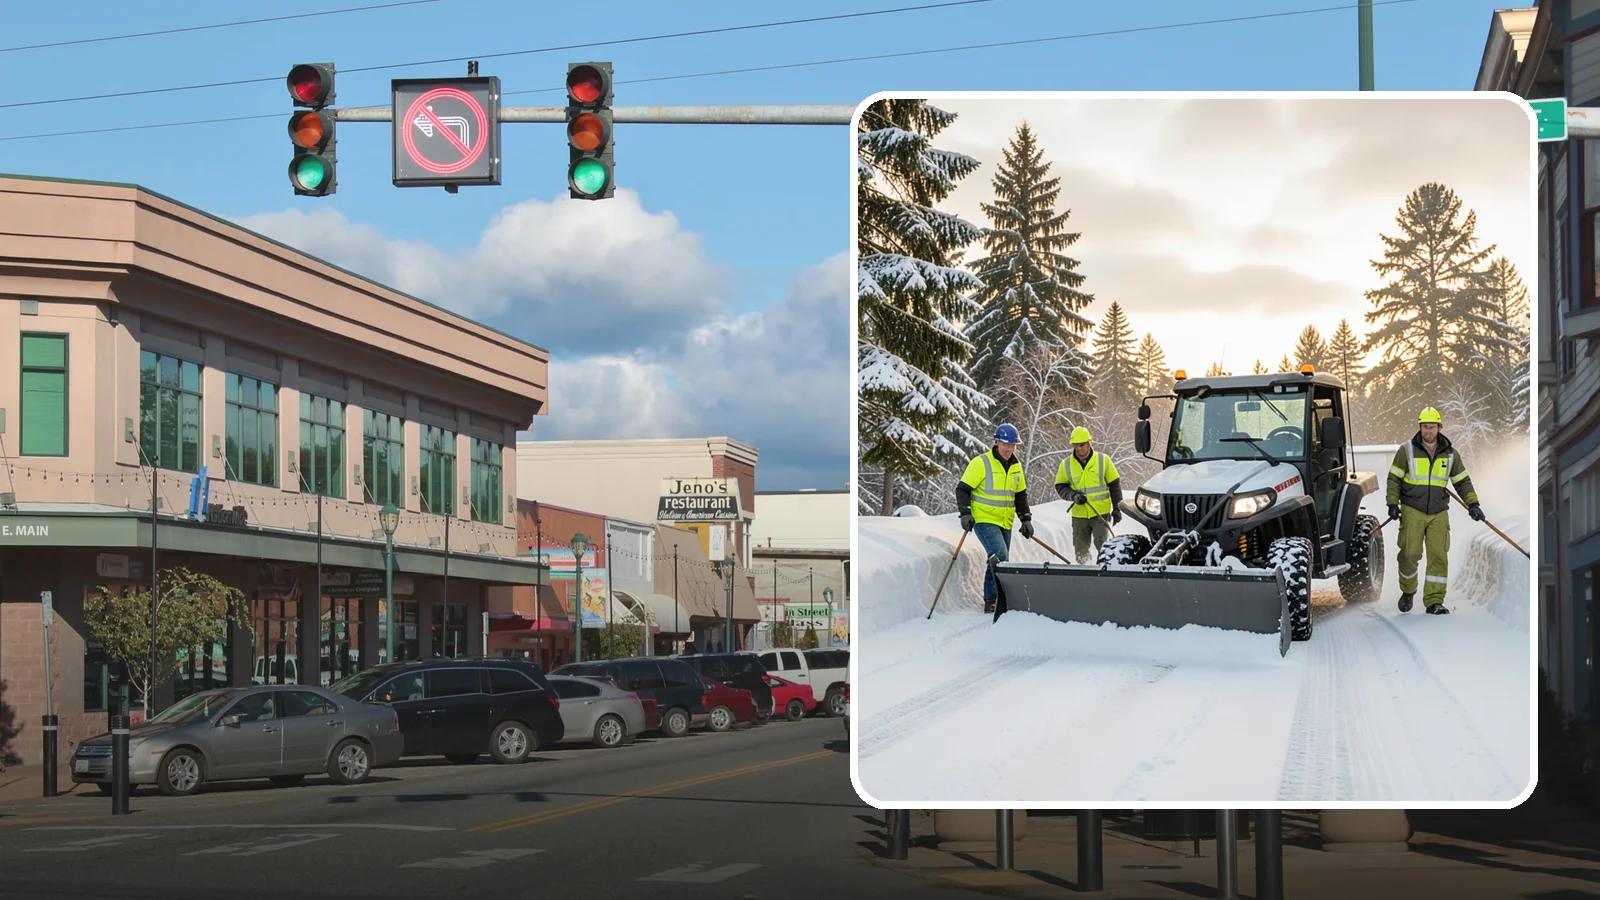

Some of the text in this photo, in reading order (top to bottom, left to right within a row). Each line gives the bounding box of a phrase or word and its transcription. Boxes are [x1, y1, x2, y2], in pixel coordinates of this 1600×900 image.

[670, 480, 727, 494] Jeno's
[665, 497, 731, 508] restaurant
[659, 510, 681, 519] Italian
[686, 510, 714, 519] American
[715, 510, 737, 519] Cuisine
[2, 525, 49, 536] E. MAIN
[797, 608, 828, 617] Street
